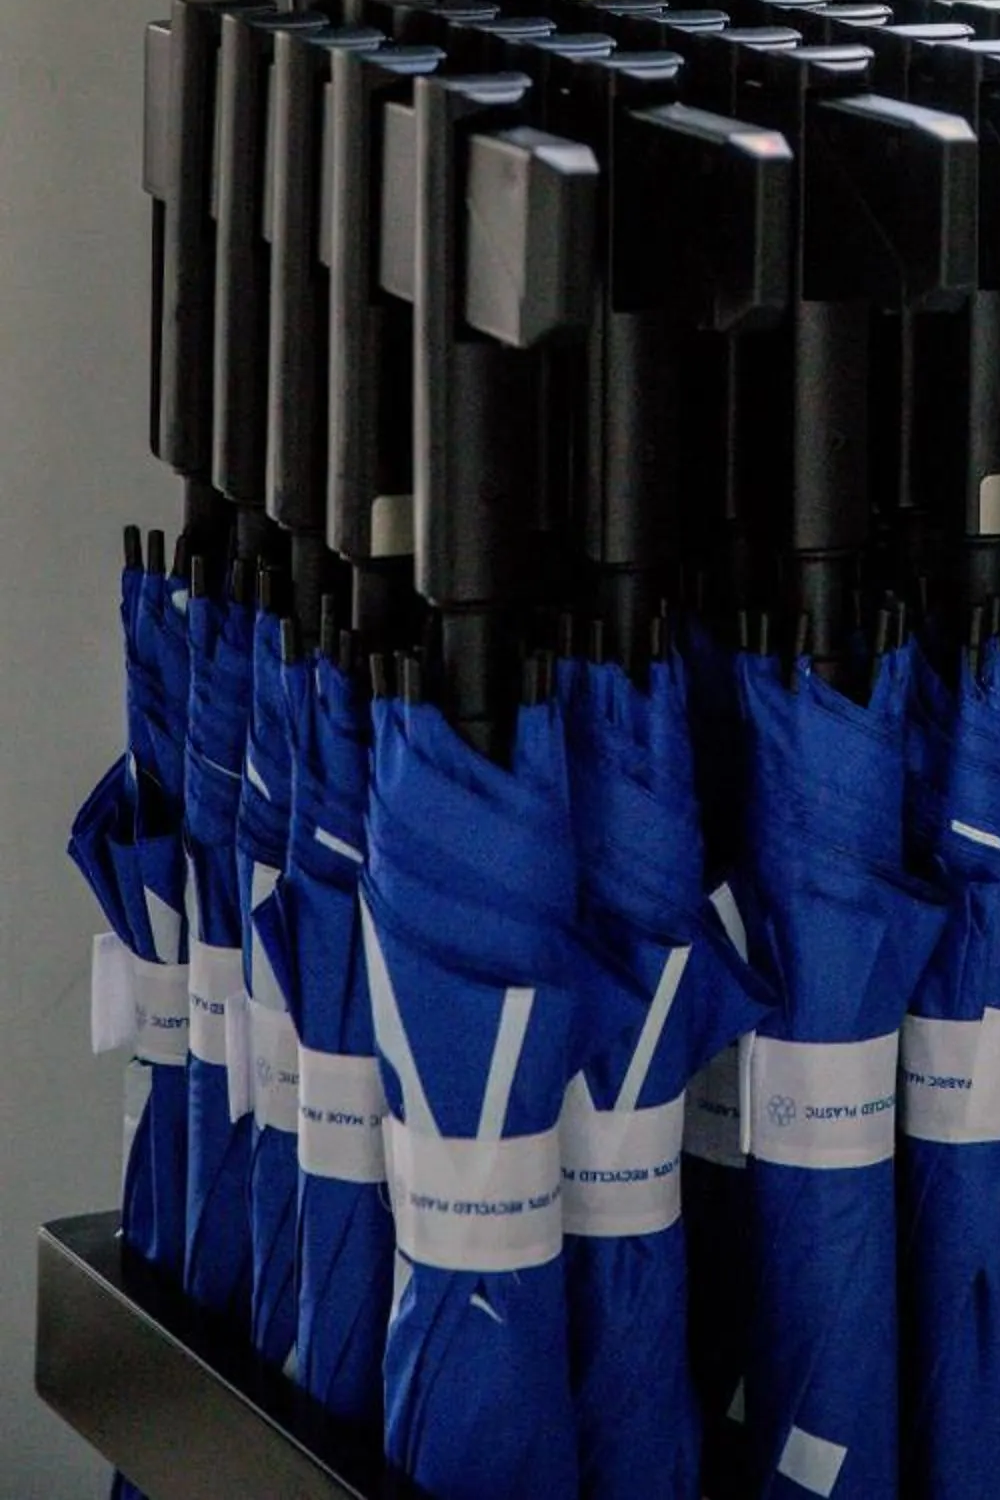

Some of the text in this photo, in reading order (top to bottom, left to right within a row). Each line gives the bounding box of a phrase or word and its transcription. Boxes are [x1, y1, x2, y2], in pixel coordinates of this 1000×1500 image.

[928, 1076, 973, 1090] FABRIC
[327, 1112, 364, 1126] MADE
[805, 1107, 856, 1119] PLASTIC
[579, 1169, 649, 1183] RECYCLED
[453, 1201, 523, 1216] RECYCLED
